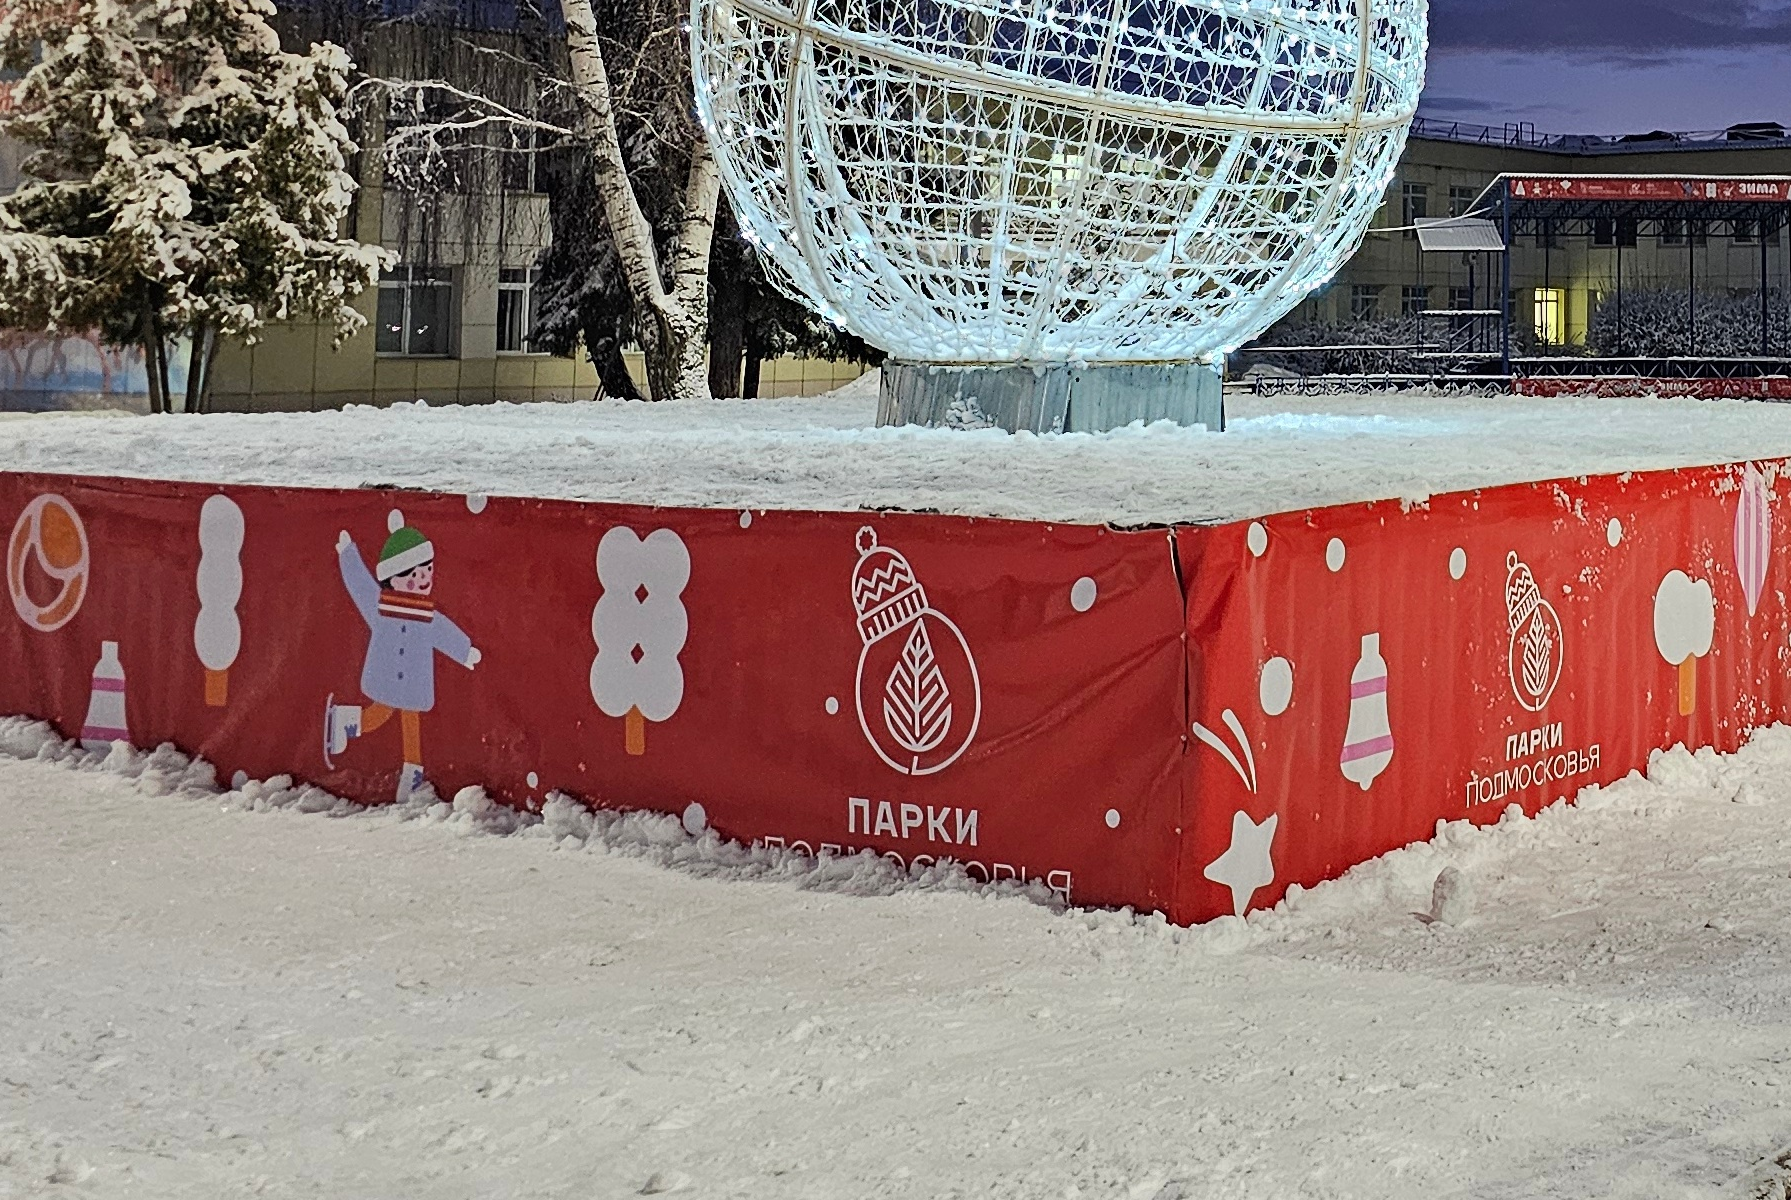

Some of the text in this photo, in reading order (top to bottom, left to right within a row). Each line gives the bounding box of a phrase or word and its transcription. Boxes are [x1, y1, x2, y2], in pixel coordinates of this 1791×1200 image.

[1738, 182, 1779, 194] ЗИМА
[1505, 722, 1563, 761] ПАРКИ
[1465, 744, 1601, 808] ПОДМОСКОВЬЯ
[848, 797, 978, 846] ПАРКИ
